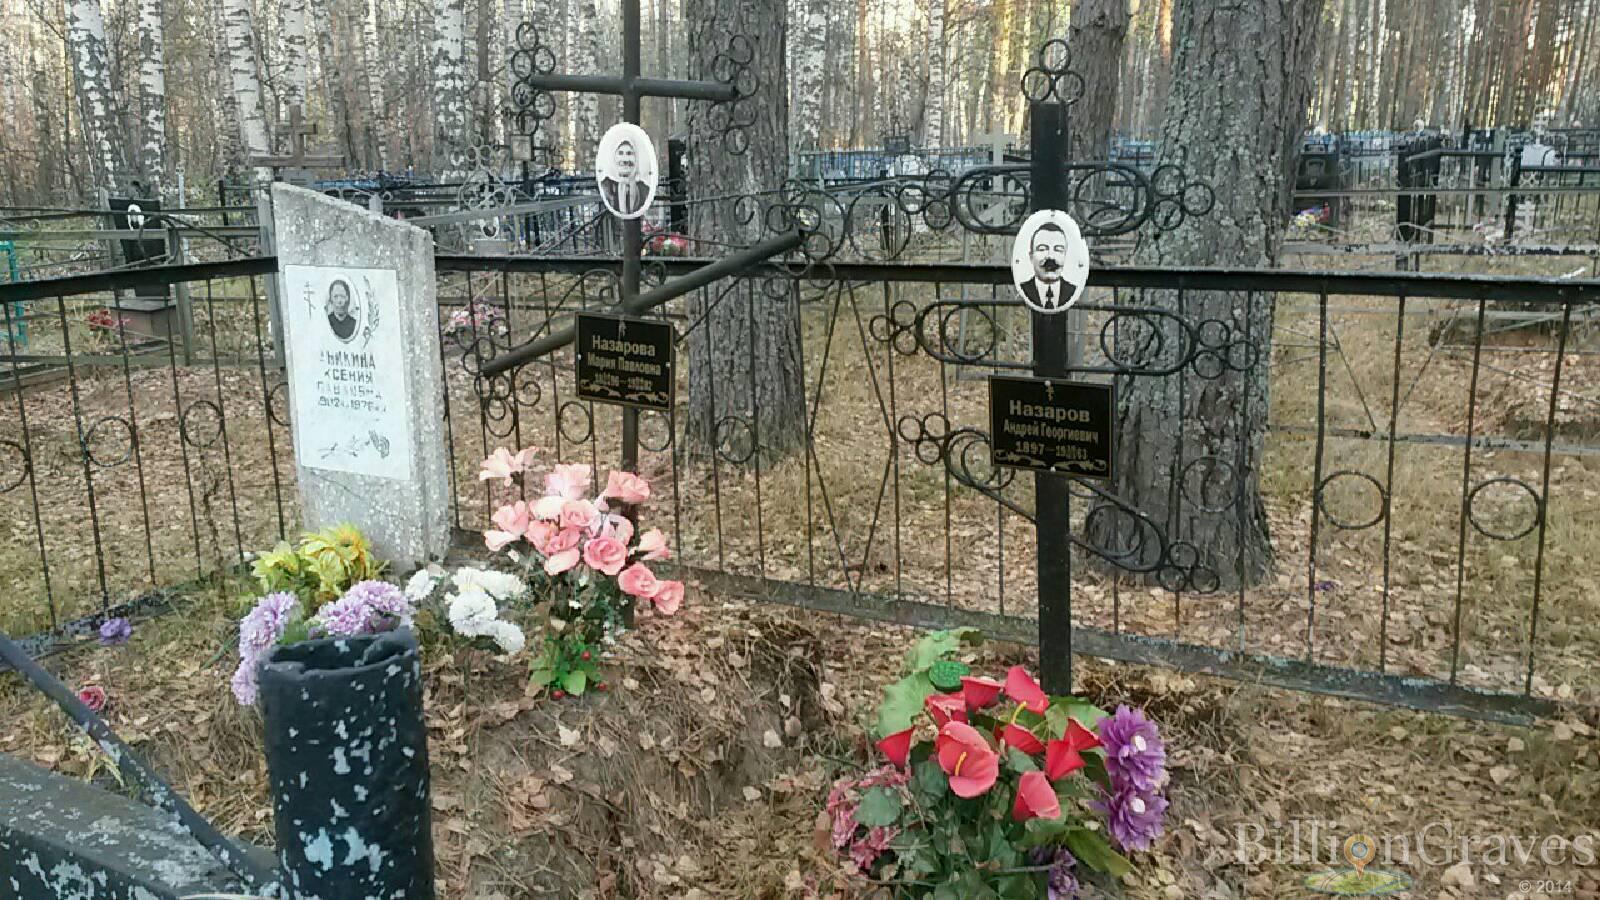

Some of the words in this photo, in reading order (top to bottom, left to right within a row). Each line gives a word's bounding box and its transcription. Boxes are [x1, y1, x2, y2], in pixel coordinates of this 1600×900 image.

[592, 334, 656, 357] Назарова
[618, 356, 661, 376] Павловна
[1009, 399, 1090, 422] Назаров
[1003, 418, 1039, 438] Андрей
[1040, 421, 1099, 444] Георгиевич
